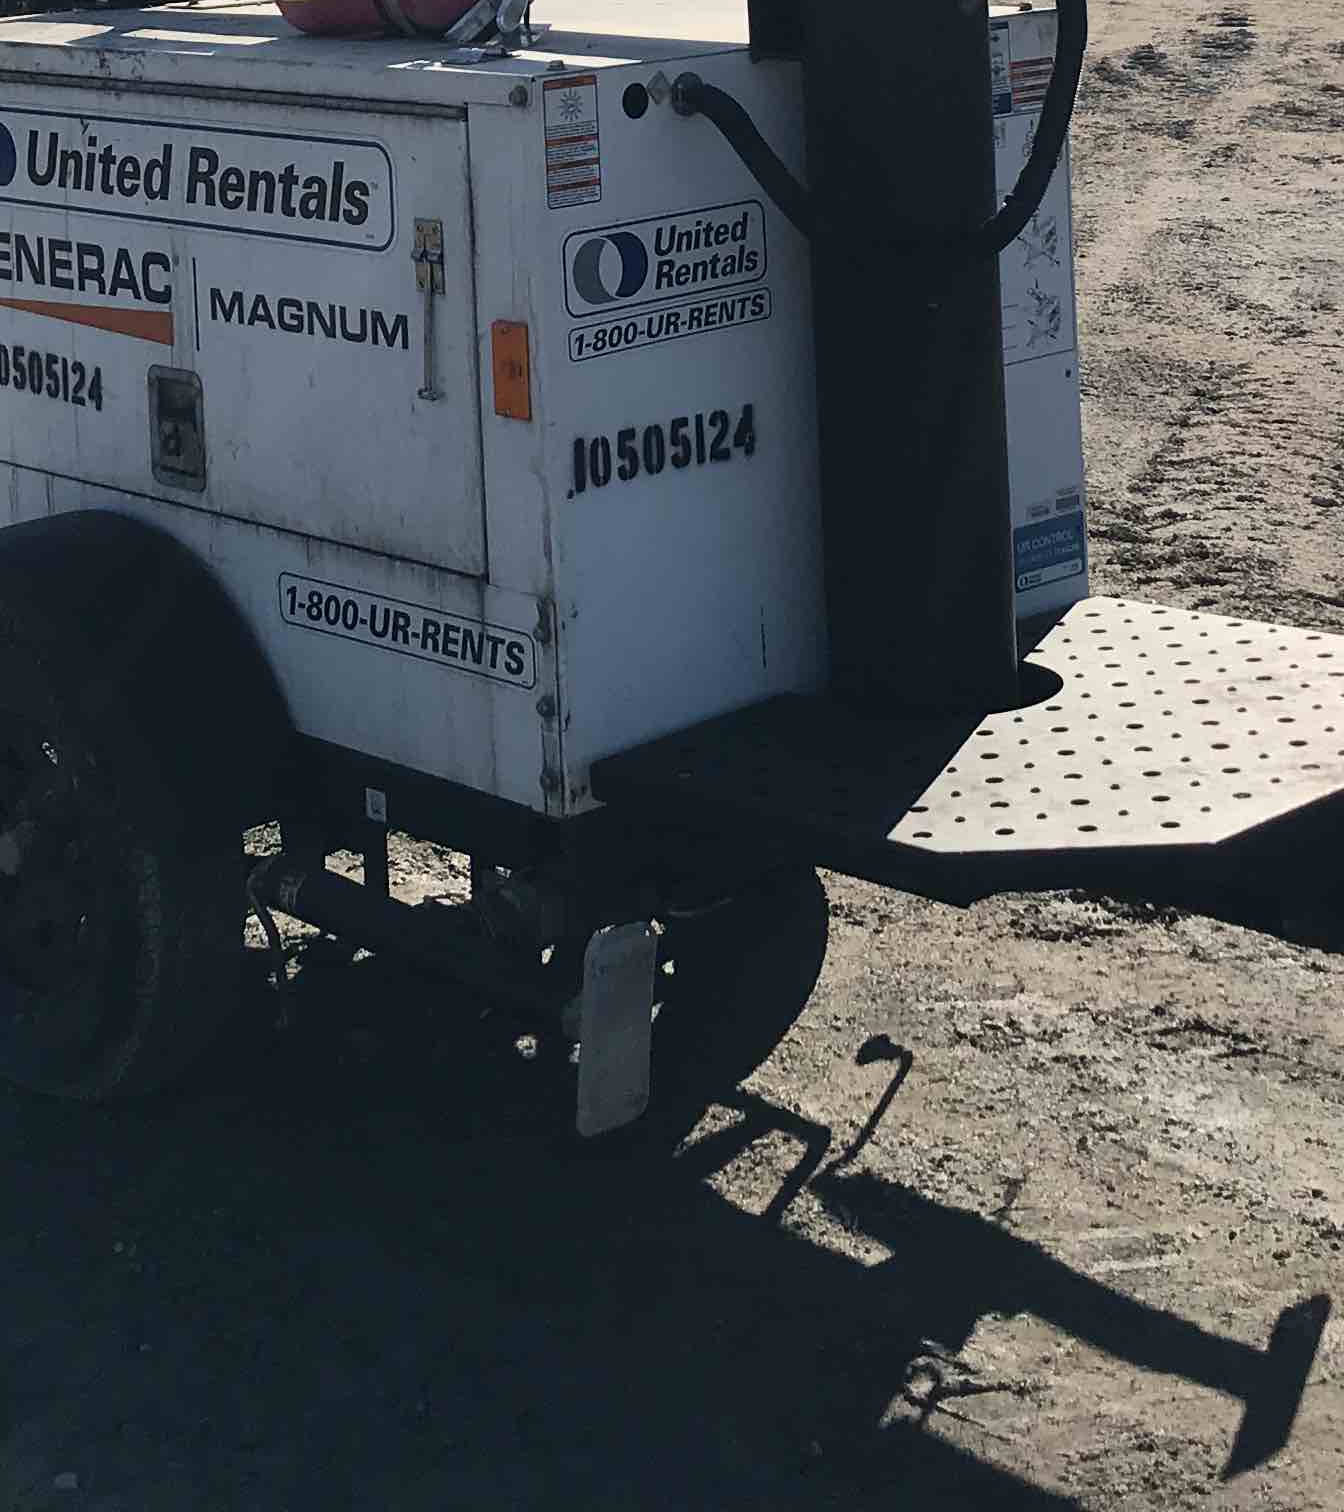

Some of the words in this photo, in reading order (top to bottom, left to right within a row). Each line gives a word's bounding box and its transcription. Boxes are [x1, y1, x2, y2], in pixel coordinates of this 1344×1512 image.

[26, 127, 174, 201] United
[185, 146, 371, 227] Rentals
[654, 211, 749, 257] United
[655, 245, 759, 290] Rentals
[209, 287, 411, 351] MAGNUM
[574, 293, 765, 356] 1-800-UR-RENTS
[572, 403, 757, 495] 10505124
[286, 586, 525, 676] 1-800-UR-RENTS
